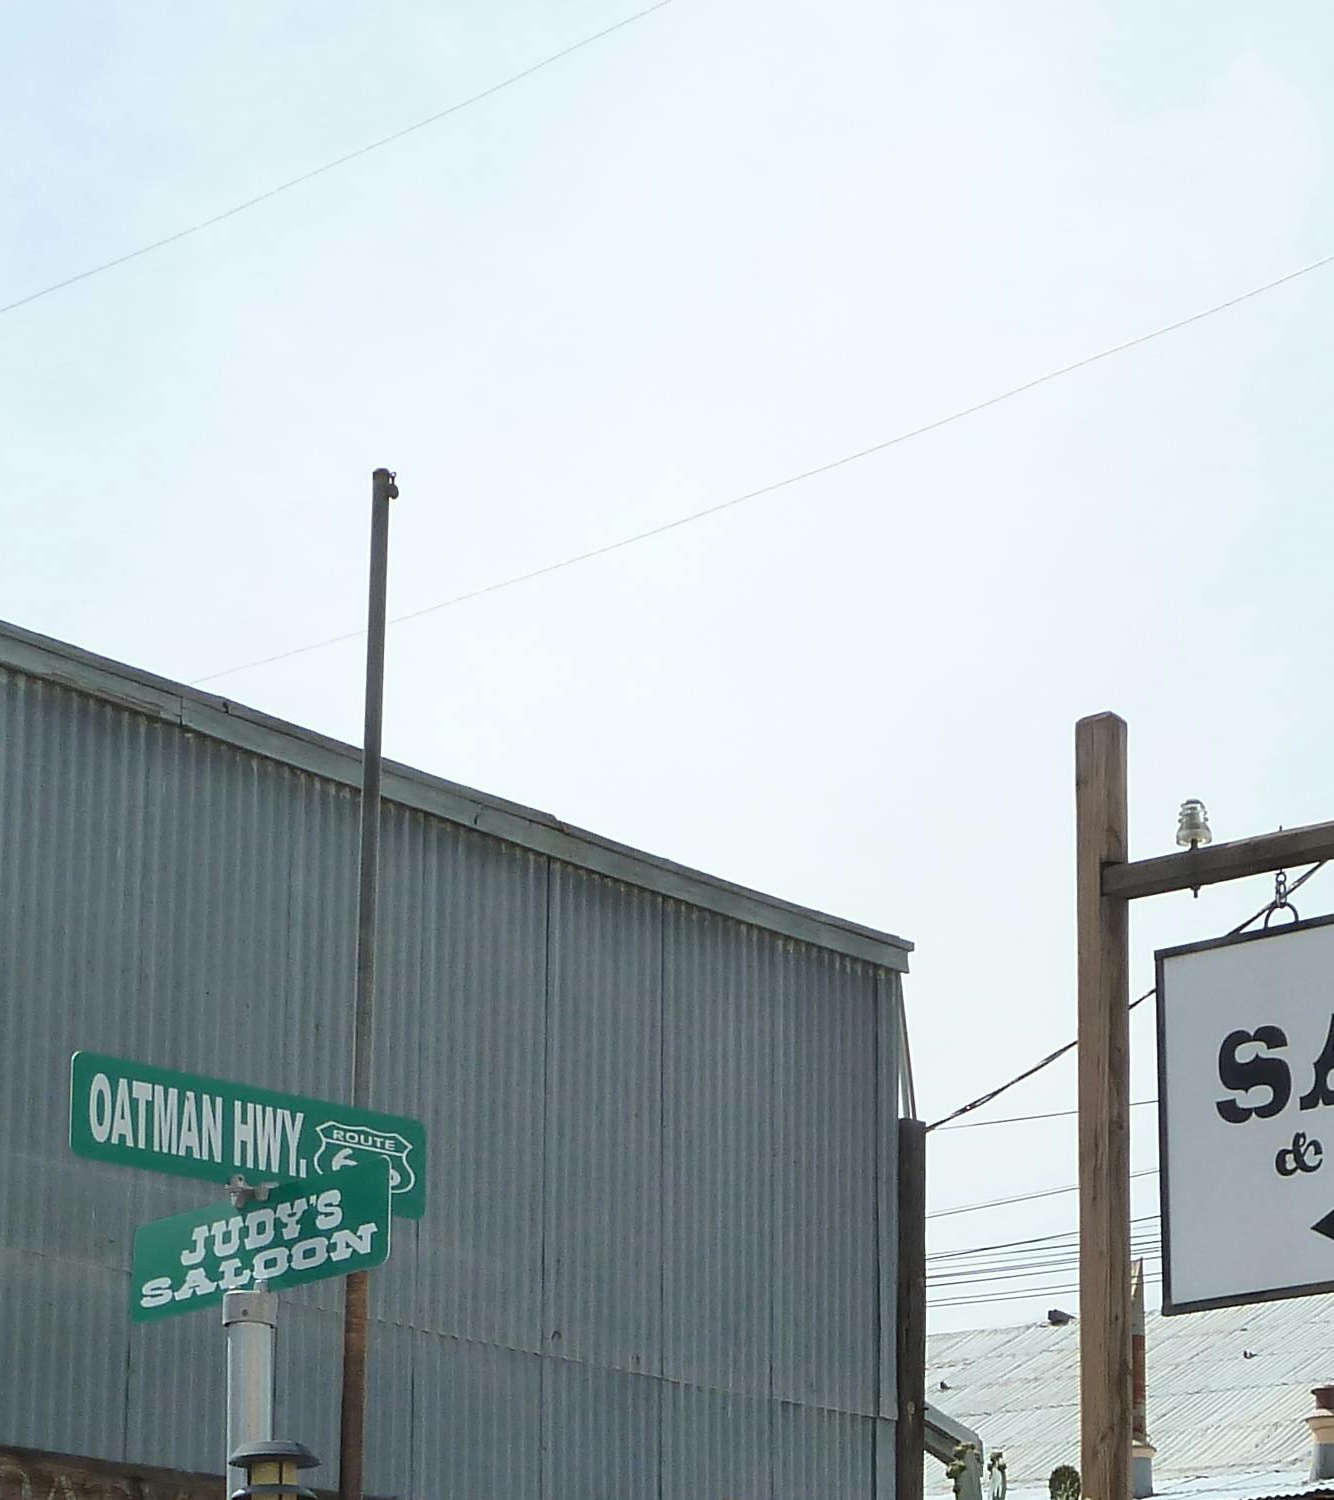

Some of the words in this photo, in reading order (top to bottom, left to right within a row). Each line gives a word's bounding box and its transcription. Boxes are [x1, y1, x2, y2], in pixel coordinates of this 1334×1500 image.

[89, 1072, 223, 1164] OATMAN
[234, 1099, 308, 1178] HWY.
[332, 1128, 396, 1151] ROUTE
[1275, 1131, 1323, 1176] &
[140, 1222, 378, 1309] SALOON
[180, 1189, 343, 1267] JUDY'S
